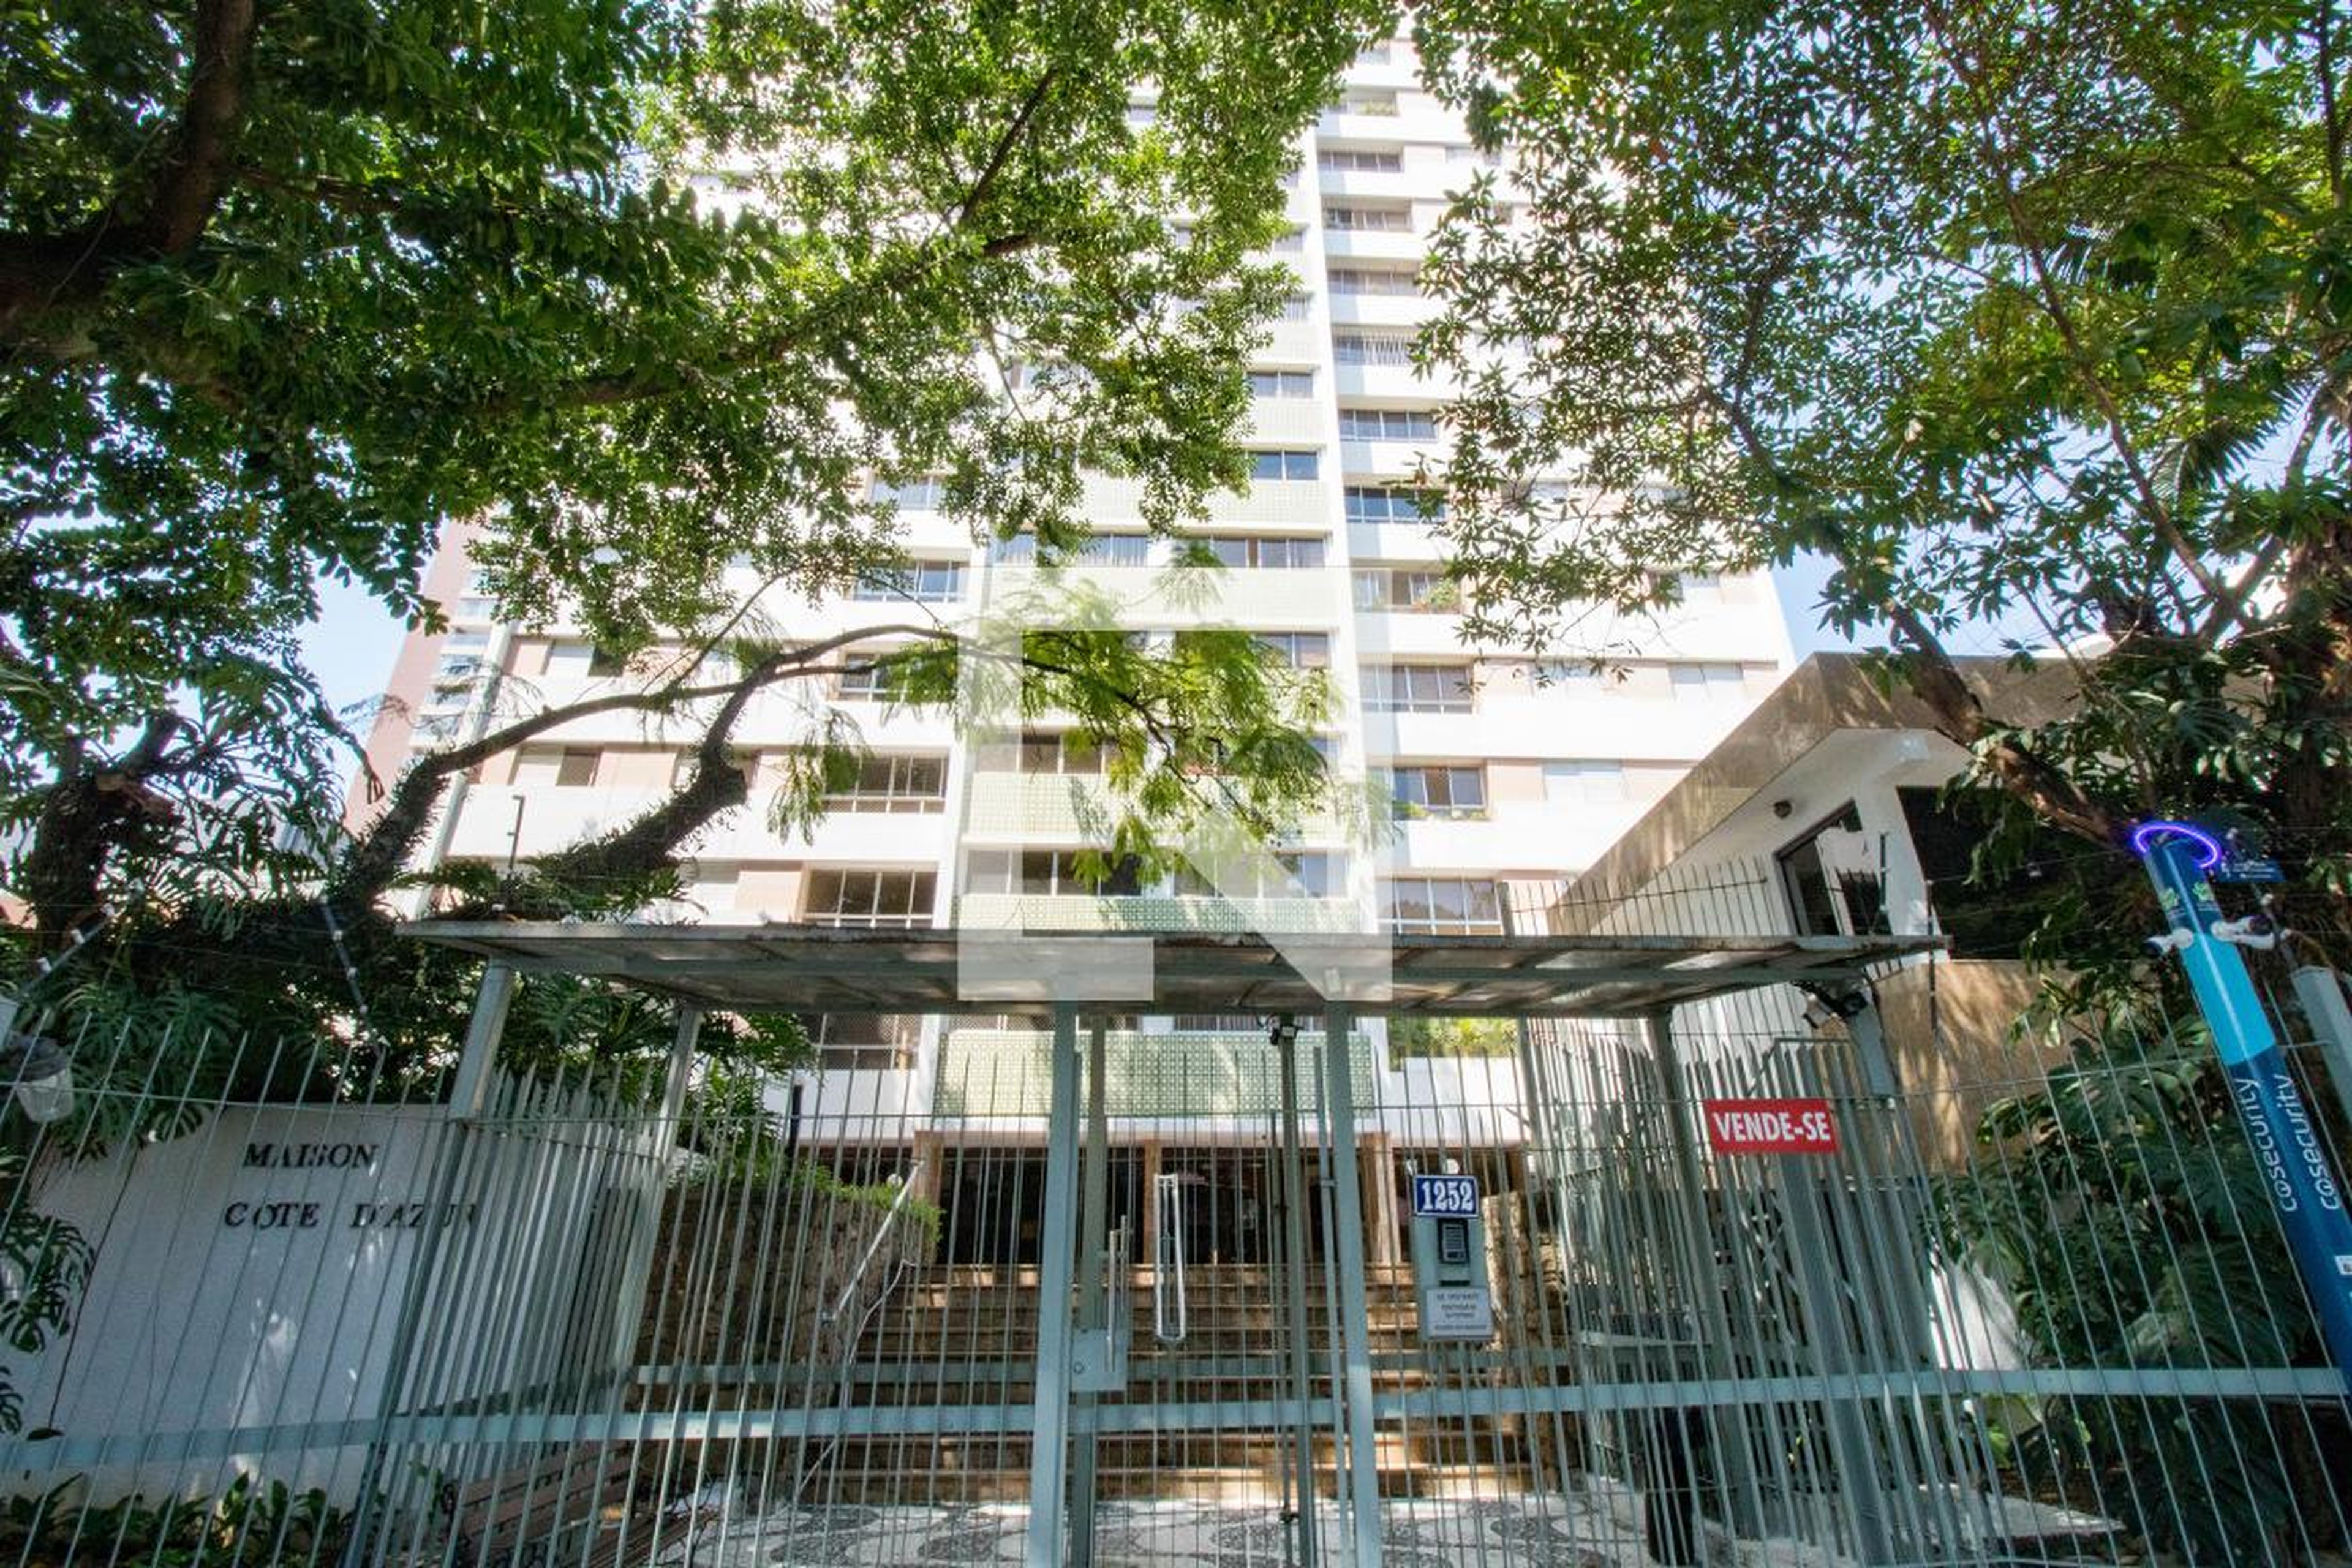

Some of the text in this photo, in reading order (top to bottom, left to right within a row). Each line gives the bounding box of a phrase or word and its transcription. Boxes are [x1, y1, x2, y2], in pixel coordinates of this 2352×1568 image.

[1713, 1112, 1830, 1141] VENDE-SE
[2274, 1074, 2340, 1210] cosecurity
[243, 1143, 379, 1168] MAISON
[2234, 1077, 2297, 1212] cosecurity
[1421, 1180, 1474, 1211] 1252
